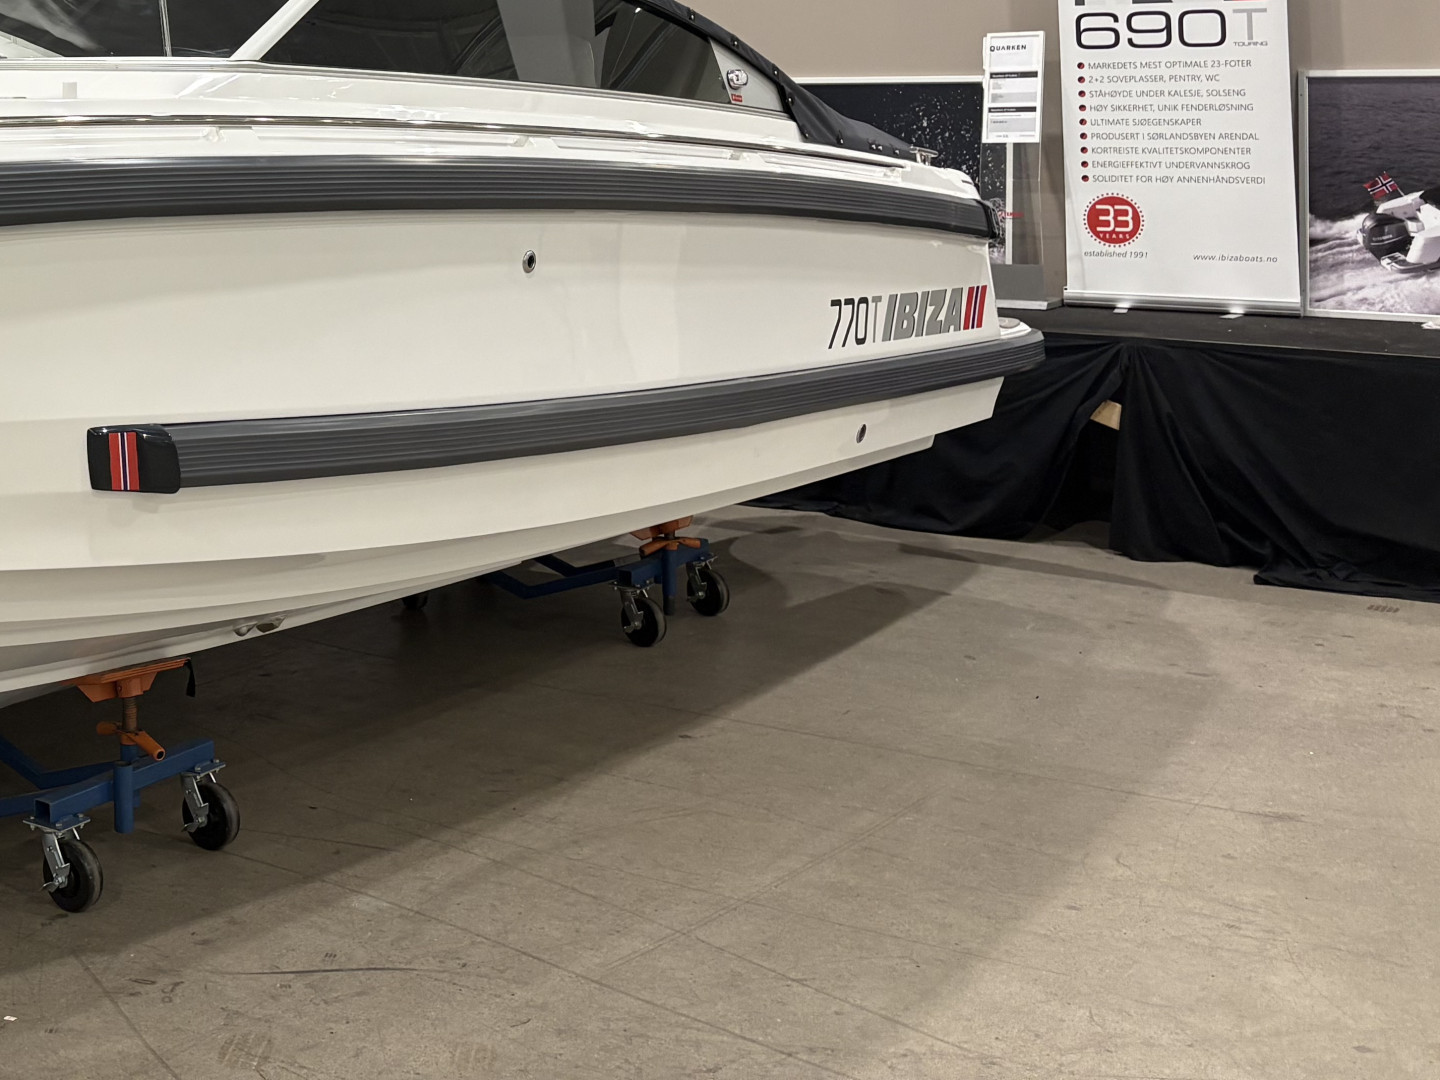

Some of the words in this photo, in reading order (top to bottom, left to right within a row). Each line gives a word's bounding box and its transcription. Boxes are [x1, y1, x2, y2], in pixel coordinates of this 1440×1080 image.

[989, 44, 1027, 52] QUARKEN
[1088, 61, 1138, 70] MARKEDETS
[1140, 61, 1162, 69] MEST
[1165, 60, 1209, 69] OPTIMALE
[1211, 59, 1252, 68] 23-FOTER
[1107, 74, 1166, 84] SOVEPLASSER,
[1169, 74, 1203, 83] PENTRY,
[1205, 73, 1220, 82] WC
[1089, 88, 1133, 98] STÅHØYDE
[1135, 90, 1165, 98] UNDER
[1167, 89, 1204, 98] KALESJE,
[1206, 88, 1246, 97] SOLSENG
[1090, 104, 1108, 113] HØY
[1110, 104, 1155, 113] SIKKERHET,
[1158, 104, 1179, 112] UNIK
[1181, 103, 1254, 112] FENDERLØSNING
[1090, 118, 1130, 126] ULTIMATE
[1132, 118, 1202, 127] SJØEGENSKAPER
[1091, 132, 1139, 141] PRODUSERT
[1142, 132, 1145, 140] I
[1147, 132, 1216, 141] SØRLANDSBYEN
[1218, 132, 1260, 141] ARENDAL
[1091, 146, 1140, 155] KORTREISTE
[1141, 146, 1252, 155] KVALITETSKOMPONENTER
[1092, 160, 1162, 169] ENERGIEFFEKTIVT
[1165, 161, 1251, 170] UNDERVANNSKROG
[1092, 175, 1134, 183] SOLIDITET
[1136, 175, 1153, 183] FOR
[1155, 175, 1174, 184] HØY
[1176, 174, 1266, 185] ANNENHÅNDSVERDI
[1095, 204, 1134, 232] 33
[1084, 250, 1127, 258] established
[1130, 251, 1148, 259] 1991
[1193, 254, 1278, 263] www.ibizaboats.no
[882, 287, 963, 342] IBIZA
